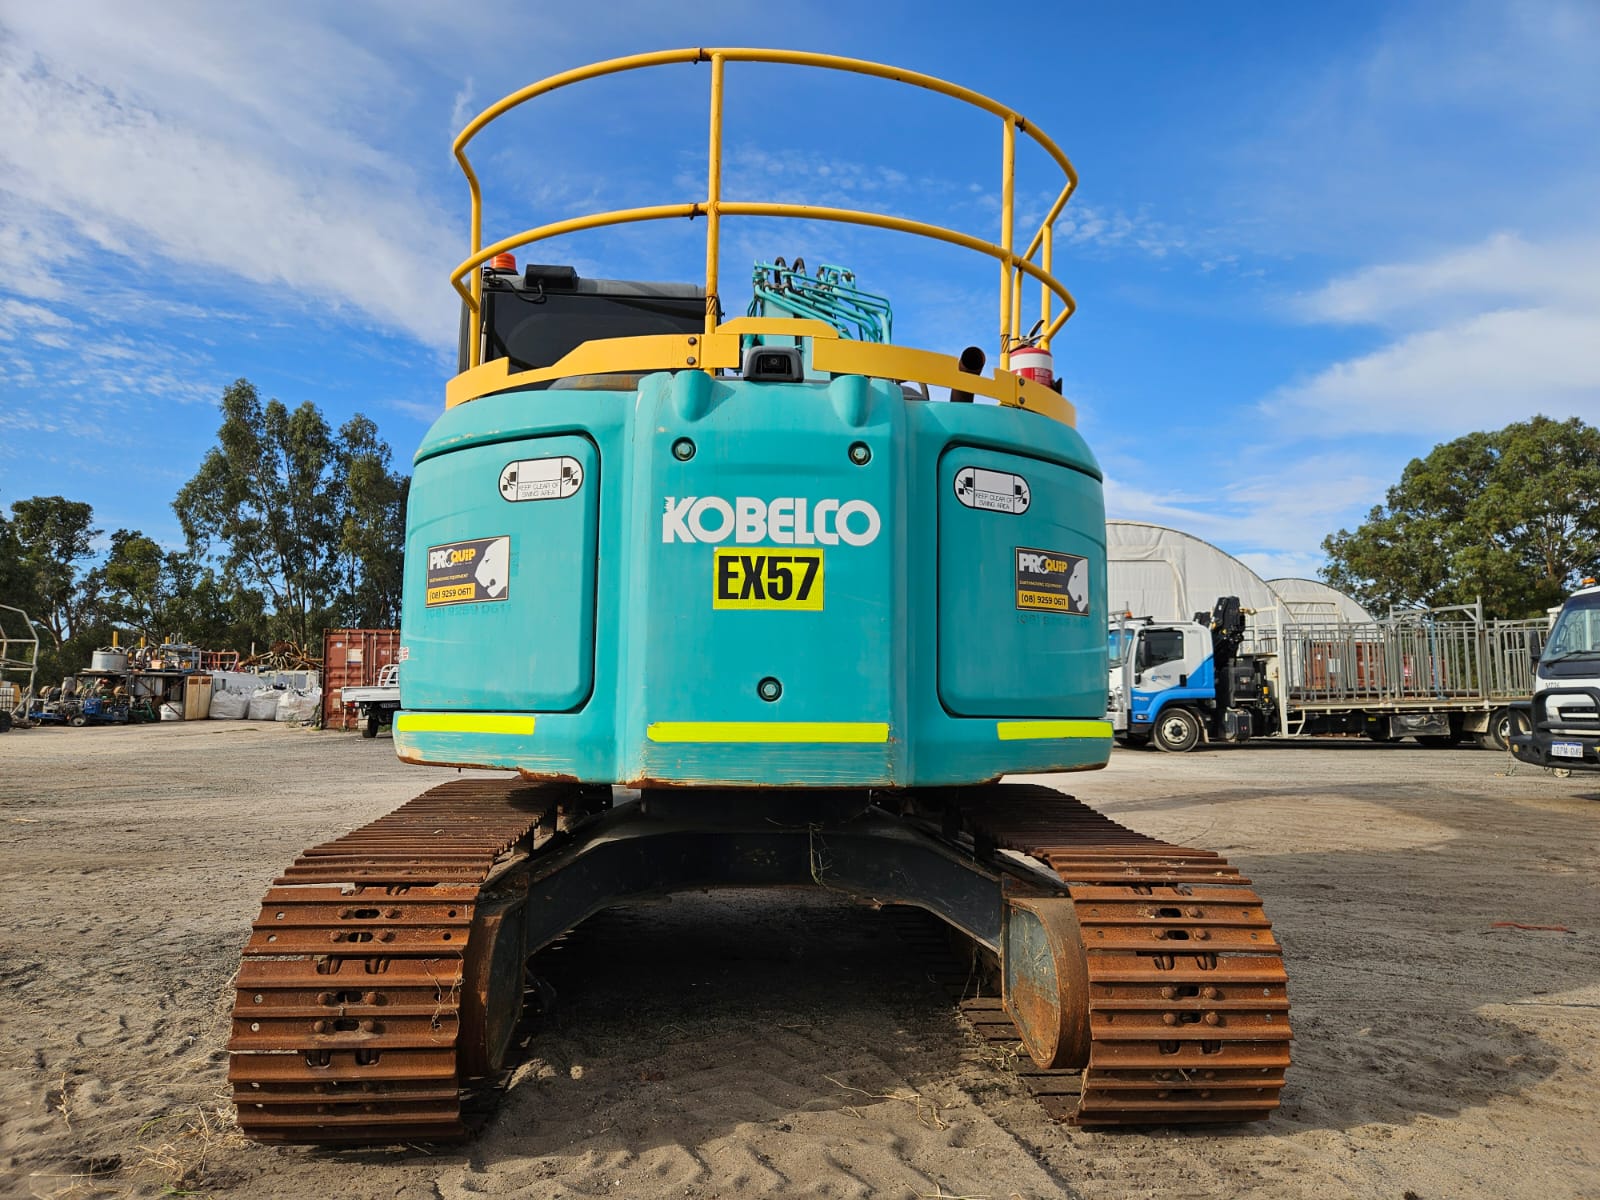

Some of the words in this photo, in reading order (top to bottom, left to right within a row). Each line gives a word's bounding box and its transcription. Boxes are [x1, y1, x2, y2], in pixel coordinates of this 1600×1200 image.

[662, 495, 881, 546] KOBELCO
[718, 555, 820, 601] EX57
[442, 590, 456, 599] 9259
[457, 587, 472, 596] 0611
[1021, 594, 1035, 604] (08)
[1037, 594, 1052, 604] 9259
